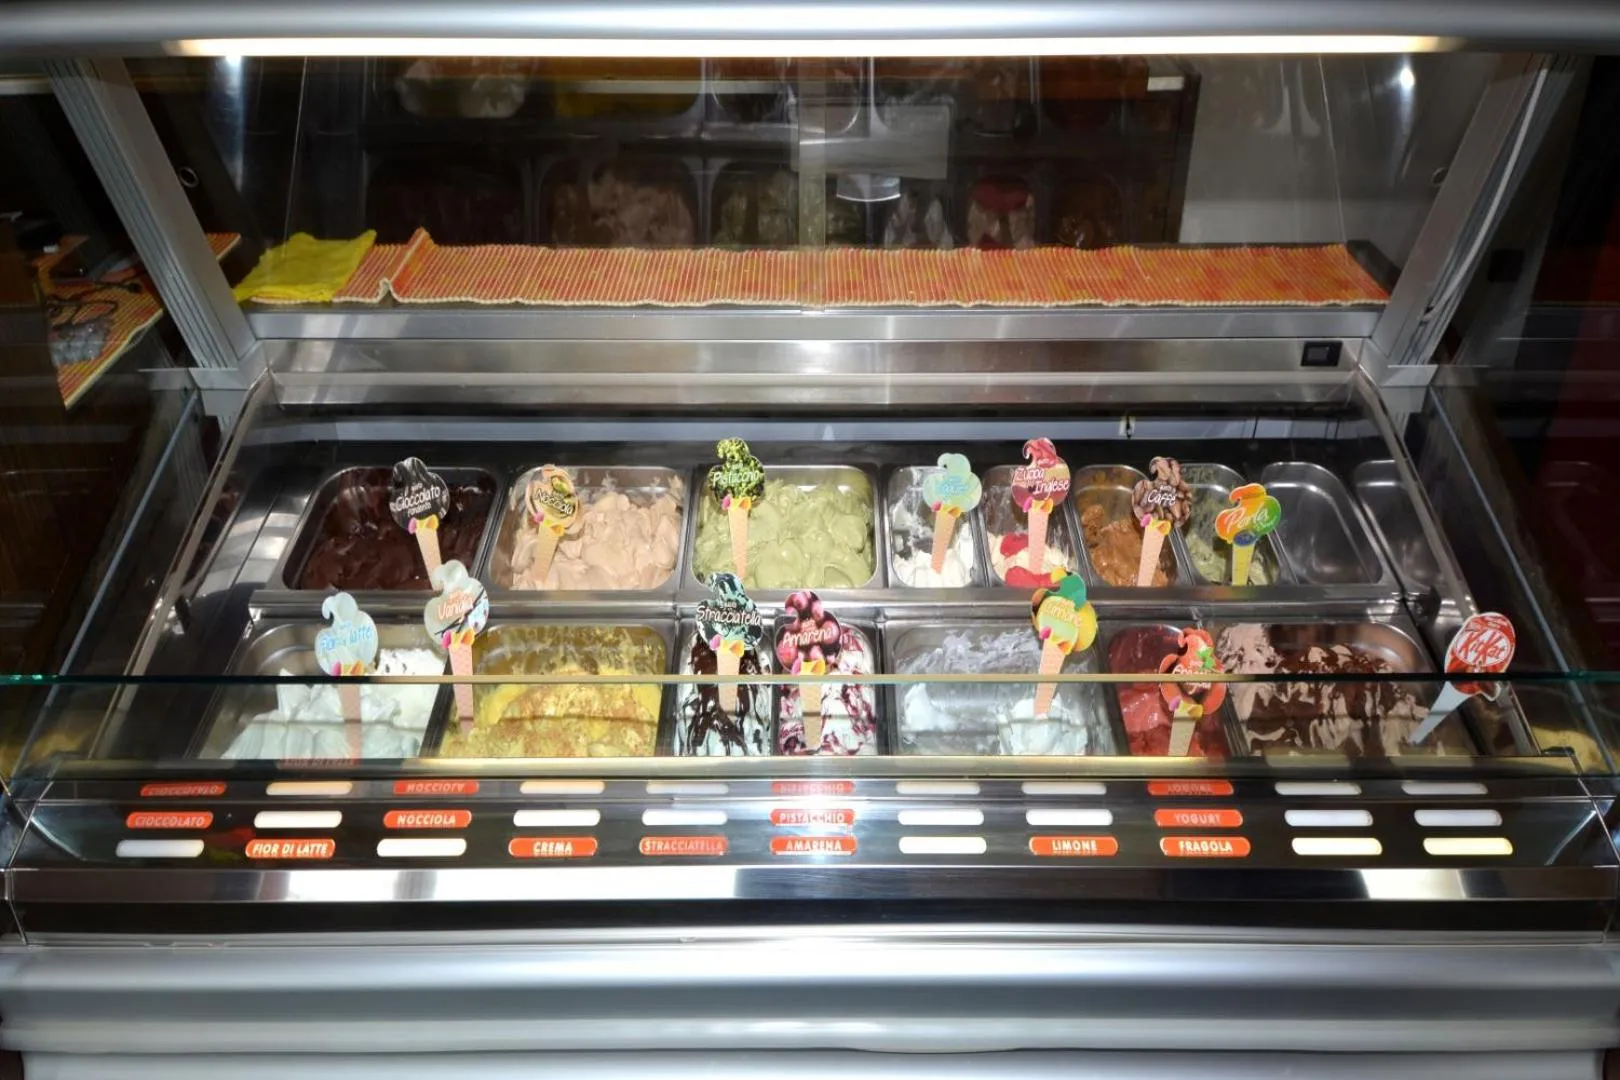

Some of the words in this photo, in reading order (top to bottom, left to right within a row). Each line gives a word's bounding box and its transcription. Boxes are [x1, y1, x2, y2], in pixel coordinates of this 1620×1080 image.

[1032, 477, 1069, 500] Inglese
[696, 605, 761, 626] Stracciatella
[782, 627, 834, 649] Amarena
[135, 816, 205, 829] CIOCCOLATO
[396, 814, 457, 826] NOCCIOLA
[780, 812, 845, 824] PISTACCHIO
[1174, 813, 1222, 825] YOGURT
[252, 842, 279, 855] FIOR
[281, 842, 295, 855] DI
[296, 842, 329, 855] LATTE
[532, 841, 573, 853] CREMA
[644, 839, 724, 851] STRACCIATELLA
[785, 839, 843, 852] AMARENA
[1051, 839, 1098, 852] LIMONE
[1178, 840, 1234, 852] FRAGOLA
